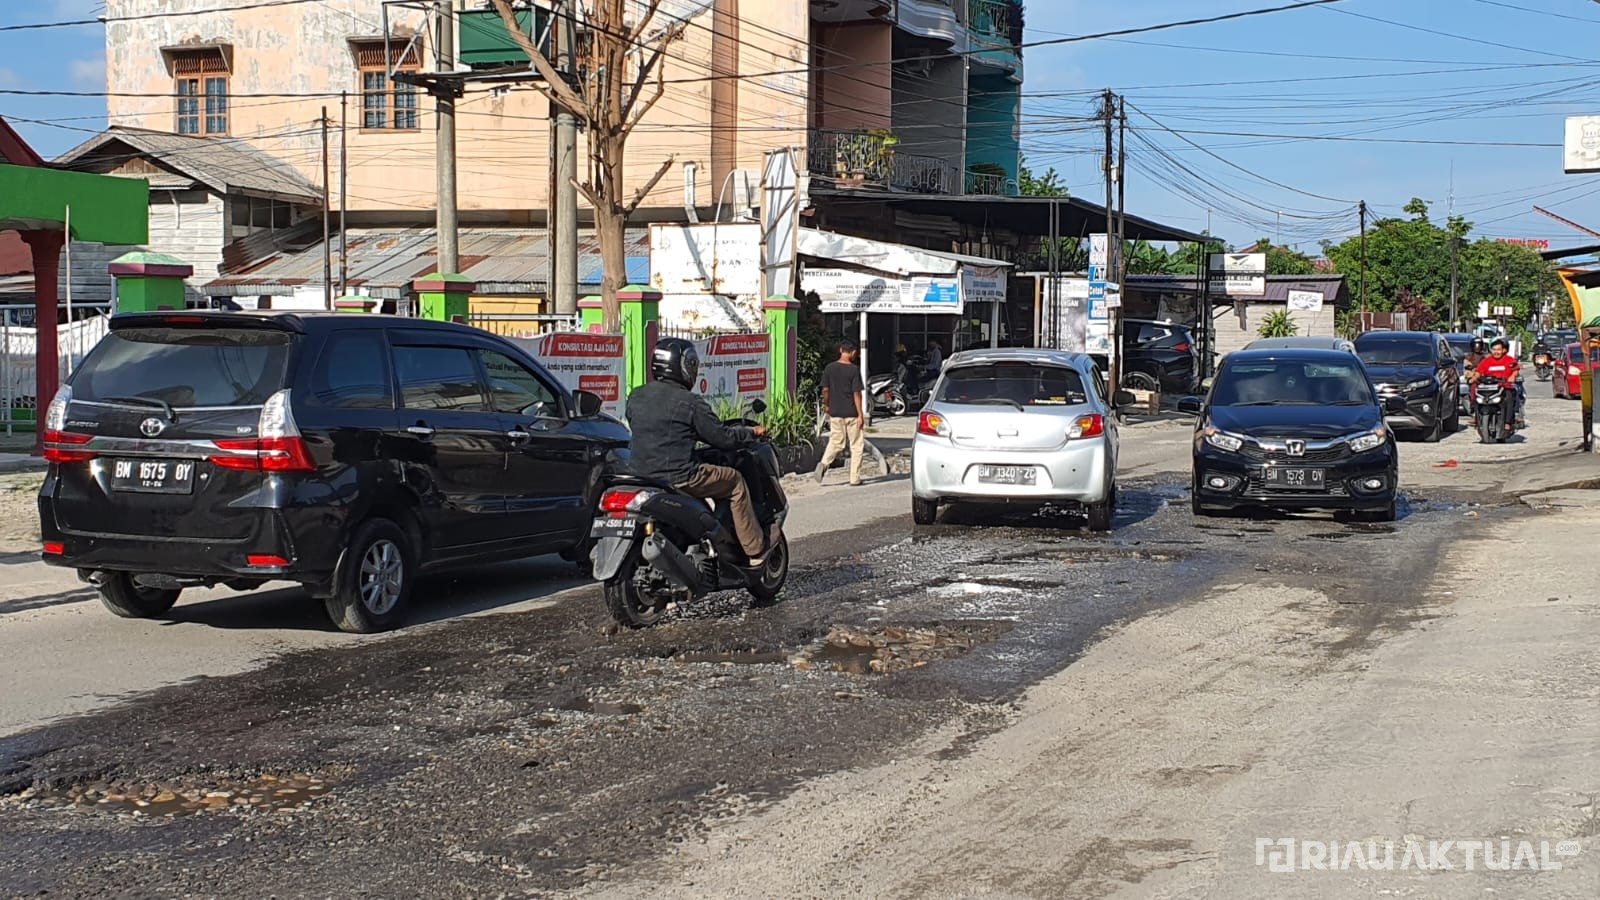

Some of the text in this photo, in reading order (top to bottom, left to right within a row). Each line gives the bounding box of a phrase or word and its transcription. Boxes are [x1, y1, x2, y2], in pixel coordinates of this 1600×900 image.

[558, 342, 593, 352] KONSULTASI
[594, 343, 604, 352] AJA
[560, 363, 574, 373] yang
[115, 461, 132, 478] BM
[139, 462, 167, 480] 1675
[979, 466, 990, 477] BM
[1266, 469, 1278, 480] BM
[1286, 469, 1305, 480] 1573
